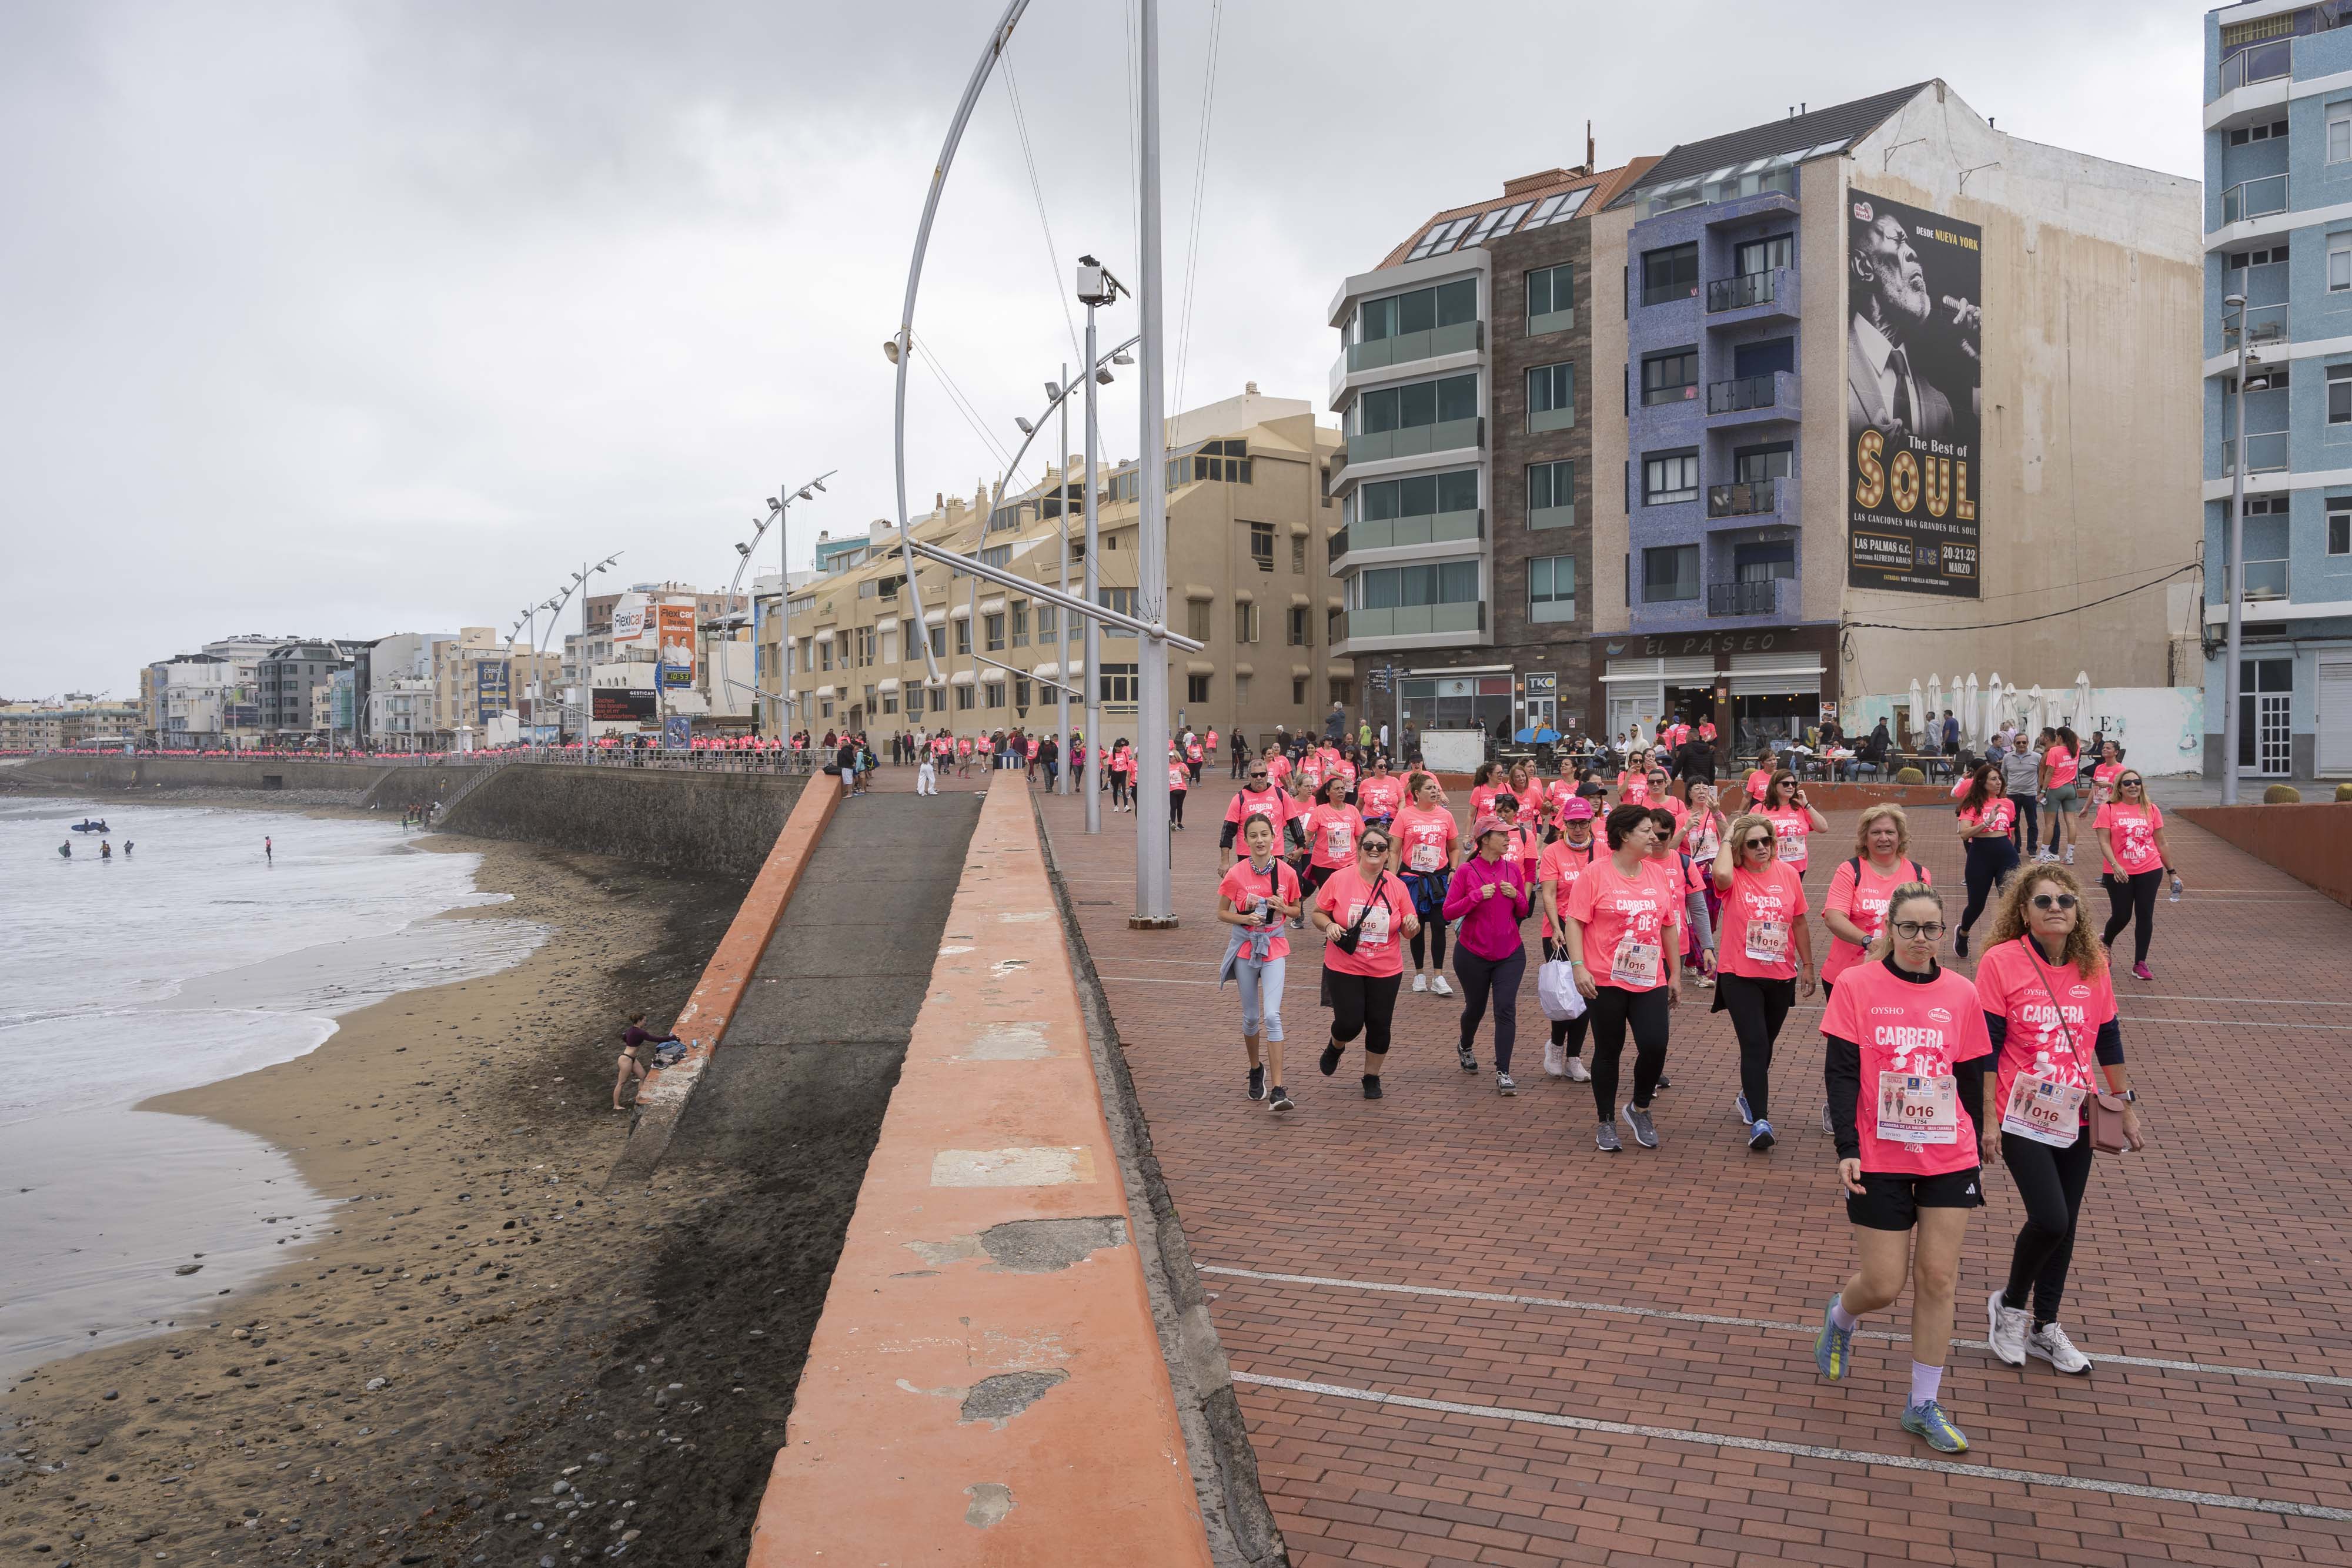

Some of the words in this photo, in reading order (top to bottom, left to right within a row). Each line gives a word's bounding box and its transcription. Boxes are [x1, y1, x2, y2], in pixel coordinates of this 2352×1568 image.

[1916, 226, 1934, 239] DESDE
[1935, 229, 1957, 245] NUEVA
[1960, 236, 1979, 251] YORK
[1908, 435, 1927, 451] The
[1932, 439, 1953, 455] Best
[1957, 445, 1967, 457] of
[1856, 430, 1975, 520] SOUL
[1854, 513, 1865, 521] LAS
[1868, 514, 1902, 526] CANCIONES
[1905, 518, 1917, 528] MÁS
[1920, 522, 1946, 532] GRANDES
[1949, 524, 1960, 534] DEL
[1962, 526, 1977, 536] SOUL
[1855, 537, 1867, 549] LAS
[1870, 539, 1897, 553] PALMAS
[1899, 545, 1910, 554] G.C.
[1874, 554, 1895, 563] ALFREDO
[1896, 556, 1911, 564] KRAUS
[1949, 562, 1970, 574] MARZO
[614, 612, 643, 627] Flexicar
[661, 609, 694, 618] Flexicar
[1646, 640, 1667, 655] EL
[1683, 634, 1774, 654] PASEO
[1529, 677, 1555, 688] TKO
[2119, 818, 2148, 826] CARRERA
[2123, 850, 2146, 859] MUJER
[1617, 900, 1657, 910] CARRERA
[1629, 962, 1645, 970] 016
[2023, 1004, 2084, 1024] CARRERA
[1875, 1025, 1943, 1049] CARRERA
[1915, 1054, 1936, 1078] DE
[1906, 1105, 1933, 1117] 016
[2032, 1107, 2059, 1122] 016
[1904, 1142, 1924, 1153] 2026
